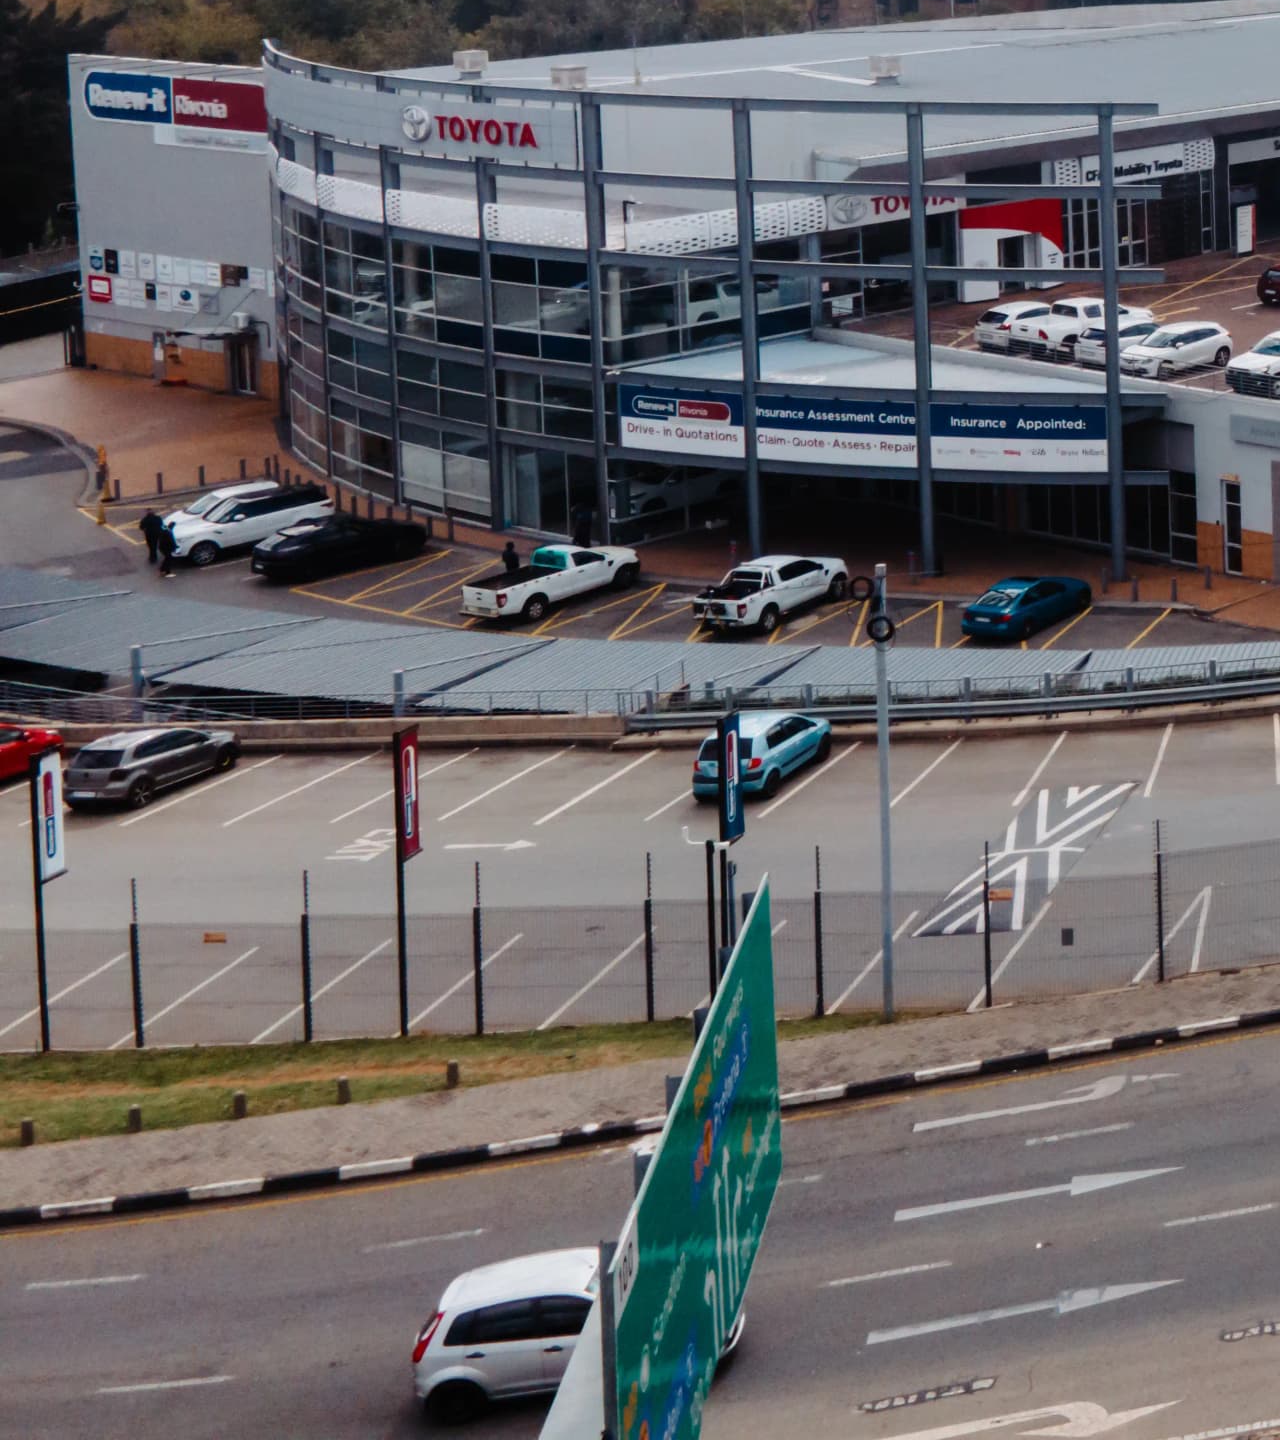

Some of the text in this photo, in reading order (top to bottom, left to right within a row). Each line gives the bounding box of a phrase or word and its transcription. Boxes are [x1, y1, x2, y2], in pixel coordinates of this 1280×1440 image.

[88, 83, 167, 113] Renew-it
[174, 94, 228, 119] Rivonia
[434, 114, 538, 149] TOYOTA
[1114, 162, 1152, 178] Mobility
[1153, 158, 1183, 173] Toyota
[637, 399, 675, 413] Renew-it
[679, 405, 709, 417] Rivonia
[755, 407, 917, 425] Insurance Assessment Centre
[627, 422, 655, 436] Drive
[675, 428, 738, 443] Quotations
[950, 415, 1087, 431] Insurance Appointed:
[757, 434, 917, 454] Claim Quote Assess Repair
